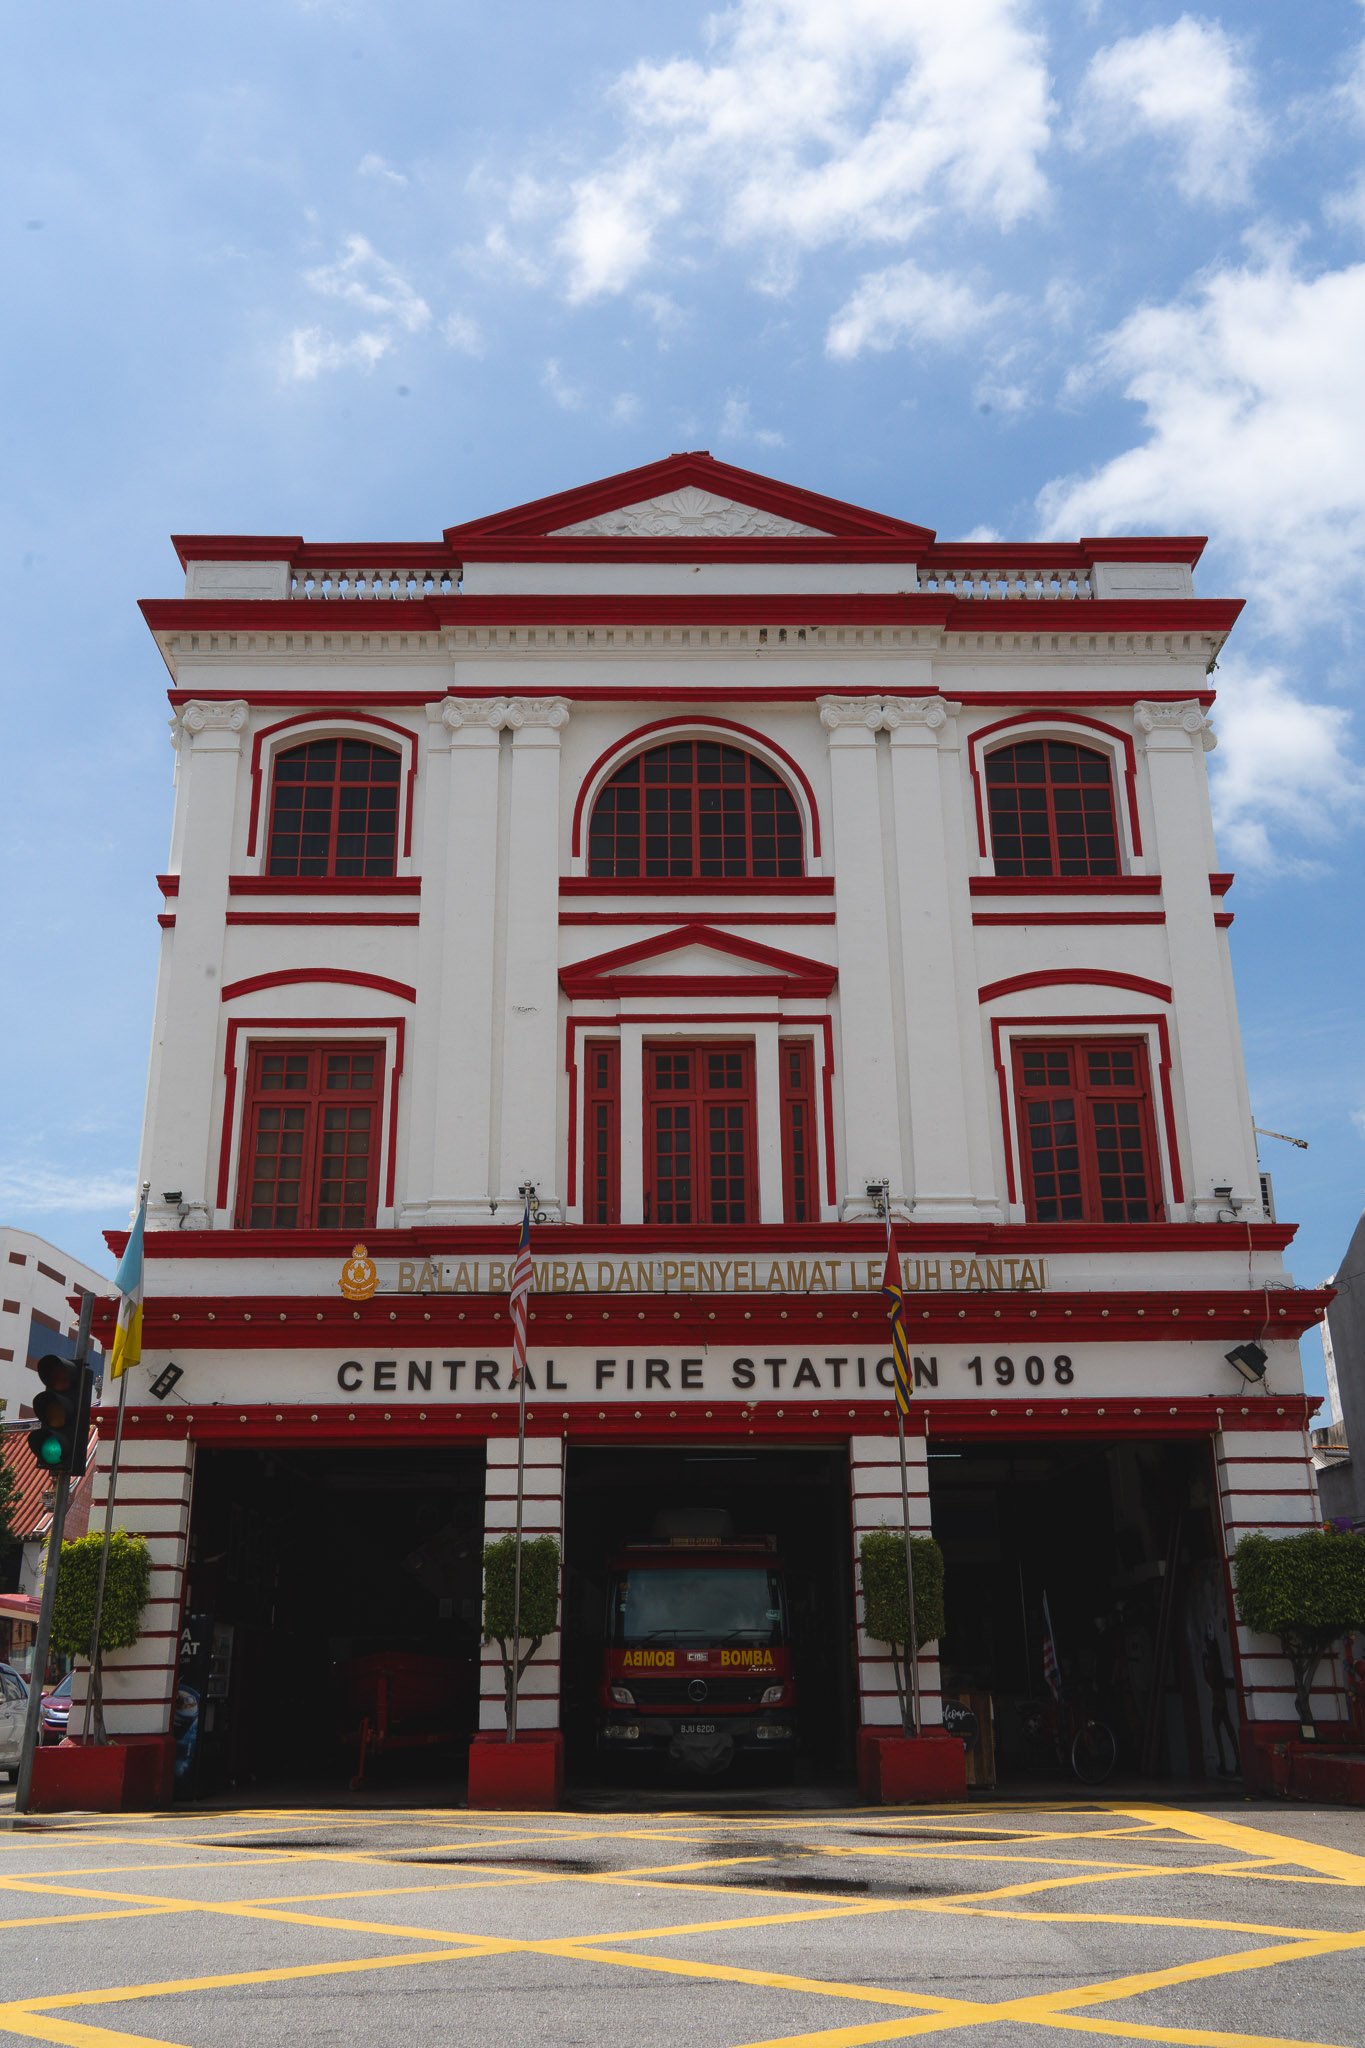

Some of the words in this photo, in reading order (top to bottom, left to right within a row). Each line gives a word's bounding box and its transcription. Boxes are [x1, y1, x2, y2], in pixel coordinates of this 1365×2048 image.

[400, 1262, 479, 1292] BALAI
[598, 1261, 652, 1291] DAN
[663, 1260, 841, 1291] PENYELAMAT
[851, 1259, 940, 1291] LEUH
[952, 1258, 1045, 1289] PANTAI
[337, 1360, 567, 1391] CENTRAL
[595, 1359, 704, 1389] FIRE
[732, 1356, 938, 1388] STATION
[968, 1355, 1074, 1386] 1908
[721, 1650, 773, 1665] BOMBA
